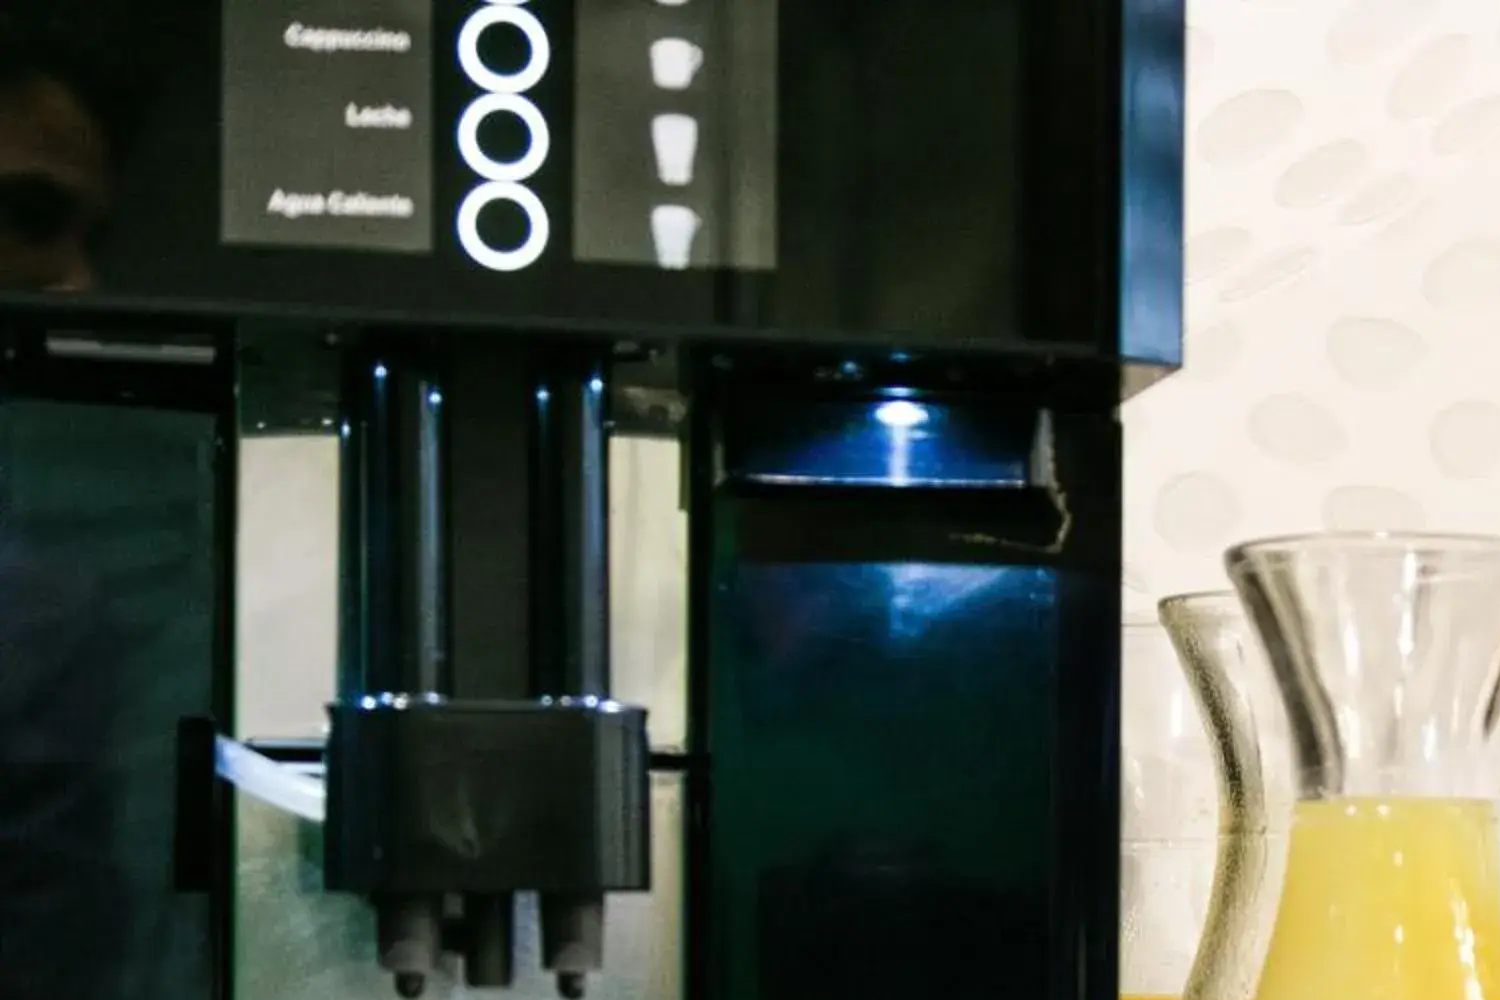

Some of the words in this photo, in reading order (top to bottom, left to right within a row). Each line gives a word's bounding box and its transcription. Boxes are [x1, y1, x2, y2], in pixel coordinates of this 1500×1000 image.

[345, 101, 413, 128] Leche
[266, 188, 325, 219] Agua
[327, 189, 414, 218] Caliente
